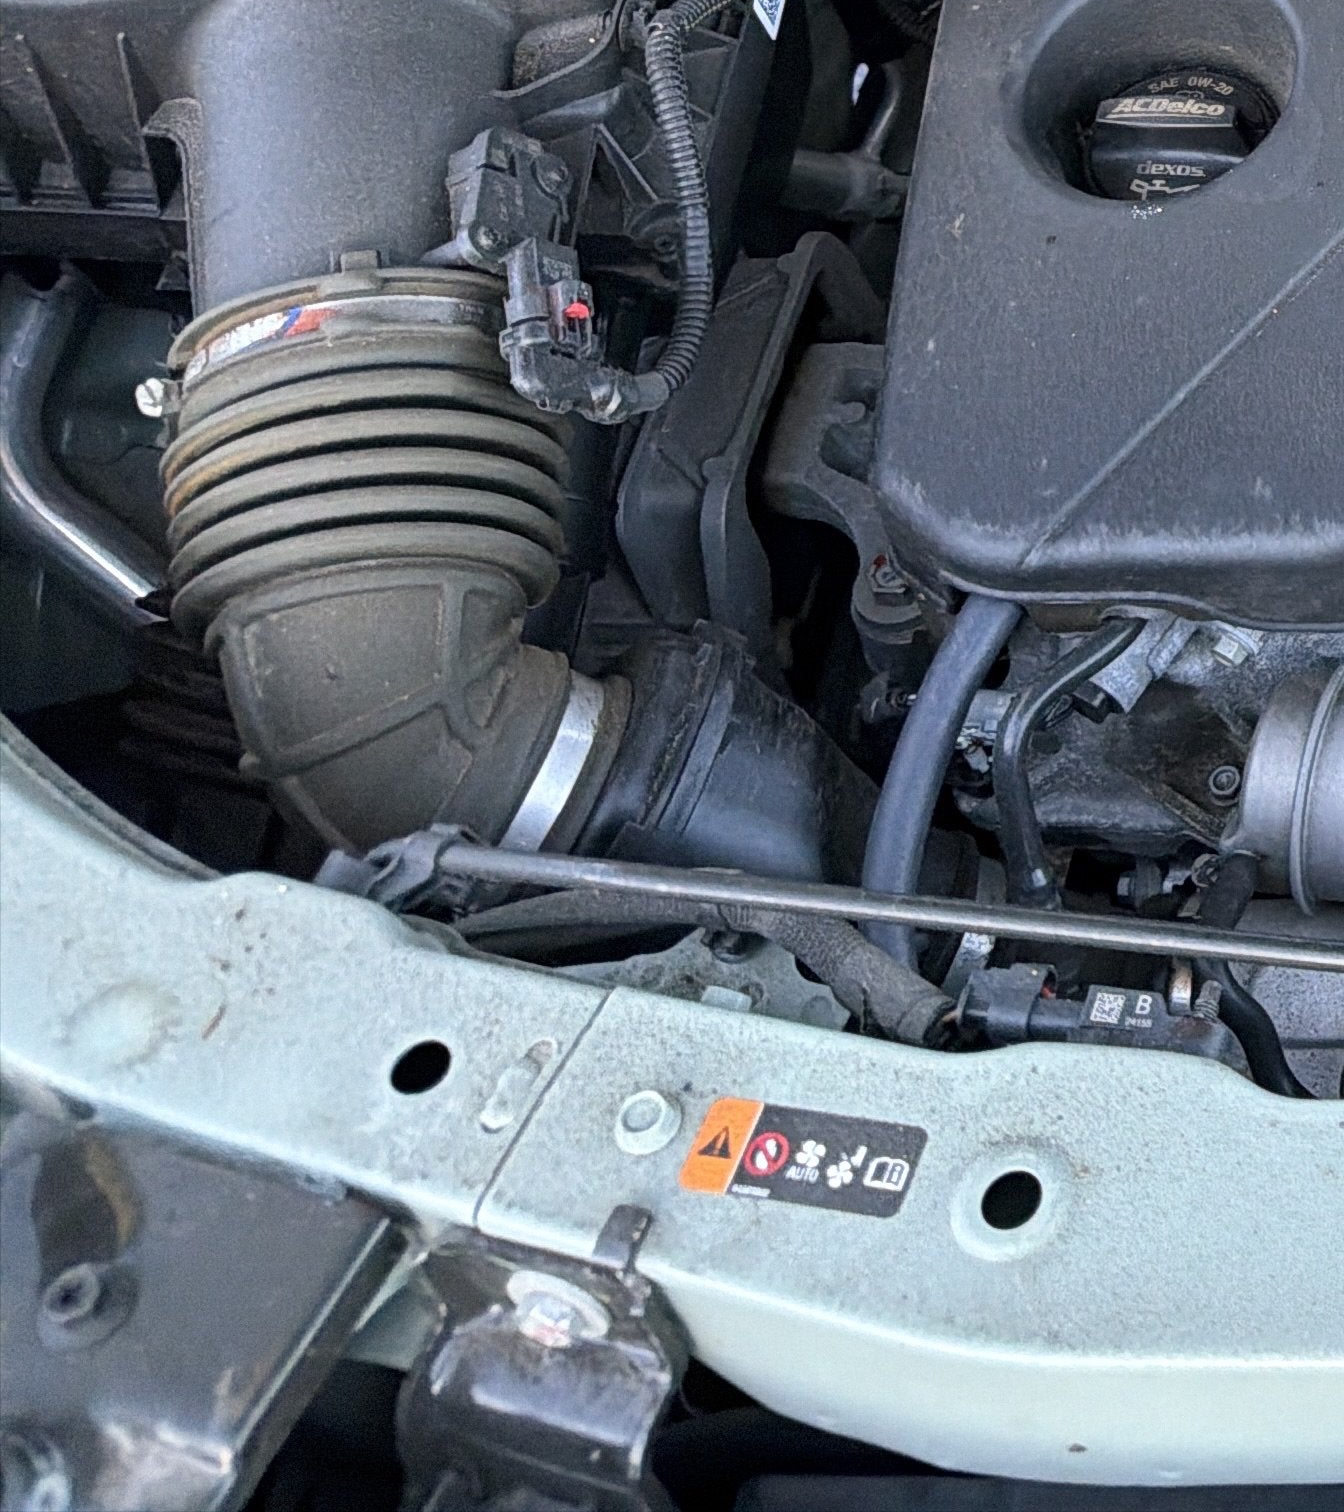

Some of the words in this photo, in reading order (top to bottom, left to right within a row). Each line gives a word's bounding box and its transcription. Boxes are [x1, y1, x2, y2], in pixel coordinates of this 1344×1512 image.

[1148, 77, 1179, 94] SAE
[1187, 76, 1235, 97] 0W-20
[1112, 97, 1226, 118] ACDelco
[1136, 160, 1204, 178] dexos
[1135, 994, 1153, 1014] B
[785, 1164, 820, 1182] AUTO
